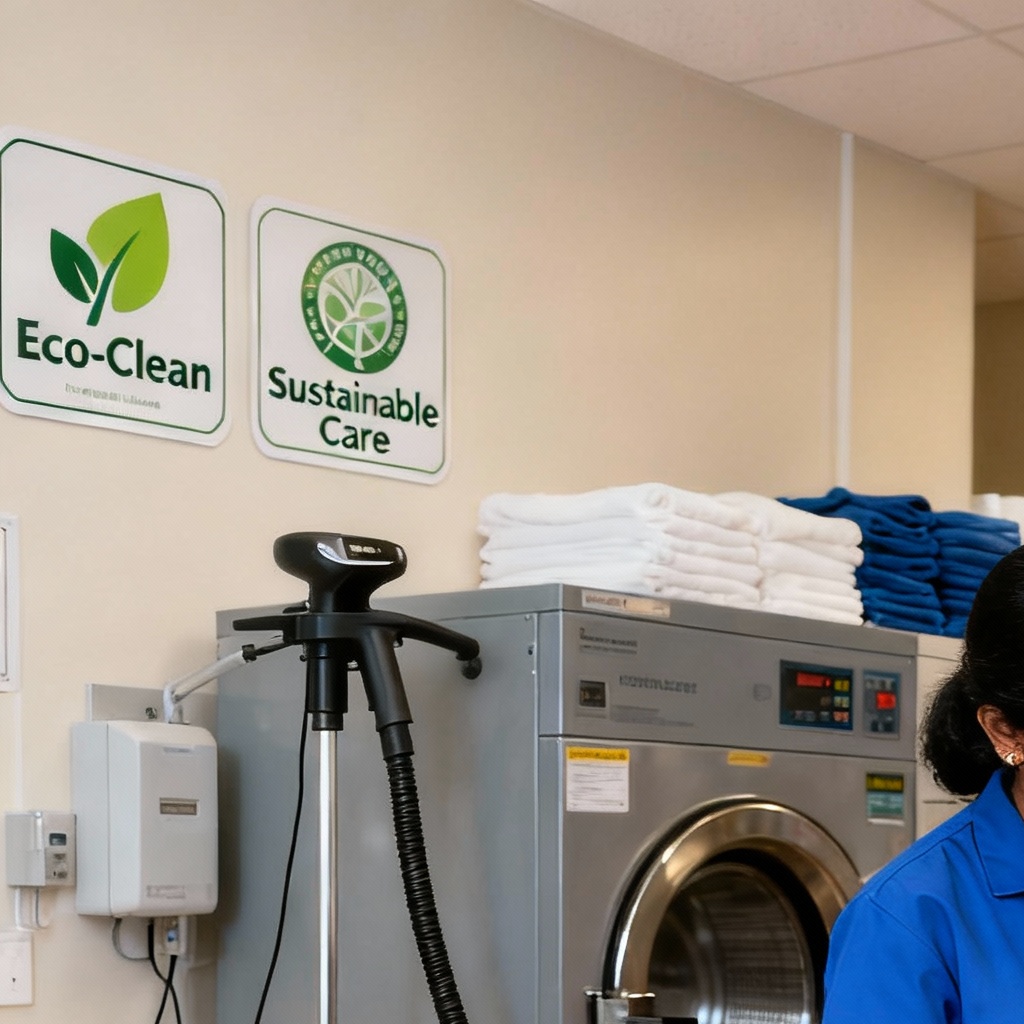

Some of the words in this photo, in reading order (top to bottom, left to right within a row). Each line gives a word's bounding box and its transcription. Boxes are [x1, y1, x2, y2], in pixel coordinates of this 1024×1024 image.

[17, 317, 211, 393] Eco-Clean
[268, 366, 439, 428] Sustainable
[319, 416, 391, 454] Care
